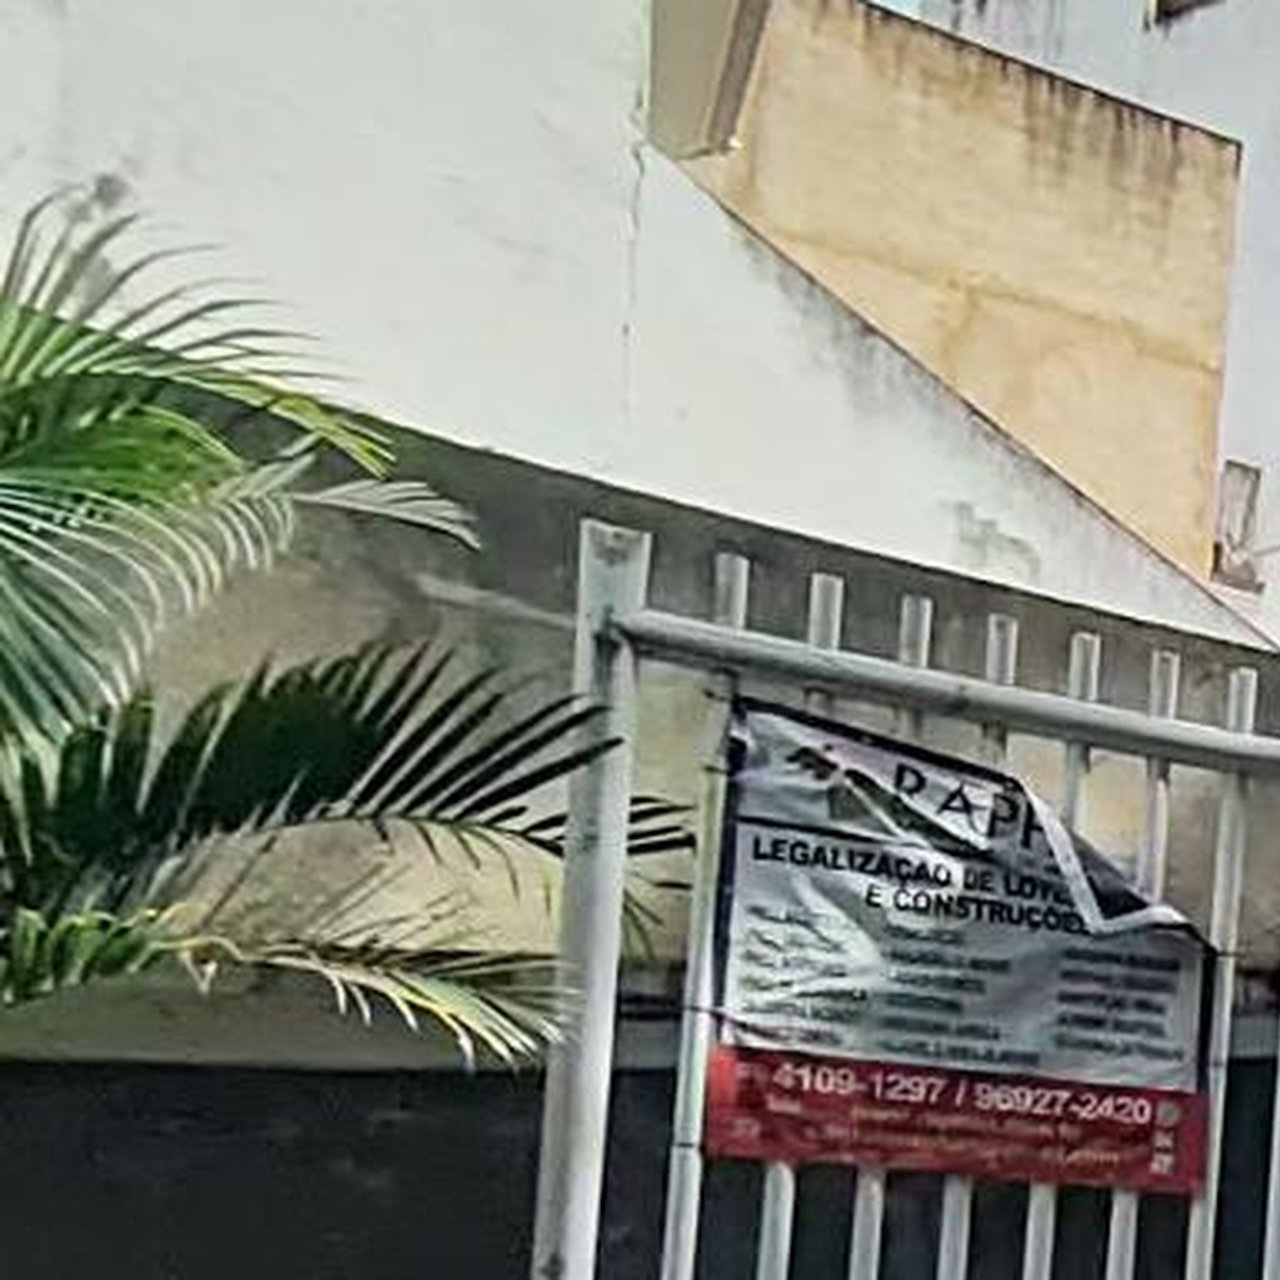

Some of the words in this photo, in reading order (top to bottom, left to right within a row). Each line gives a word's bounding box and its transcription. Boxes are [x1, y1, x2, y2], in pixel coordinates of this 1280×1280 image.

[963, 867, 995, 891] DE
[866, 884, 881, 908] E
[955, 1080, 967, 1107] /
